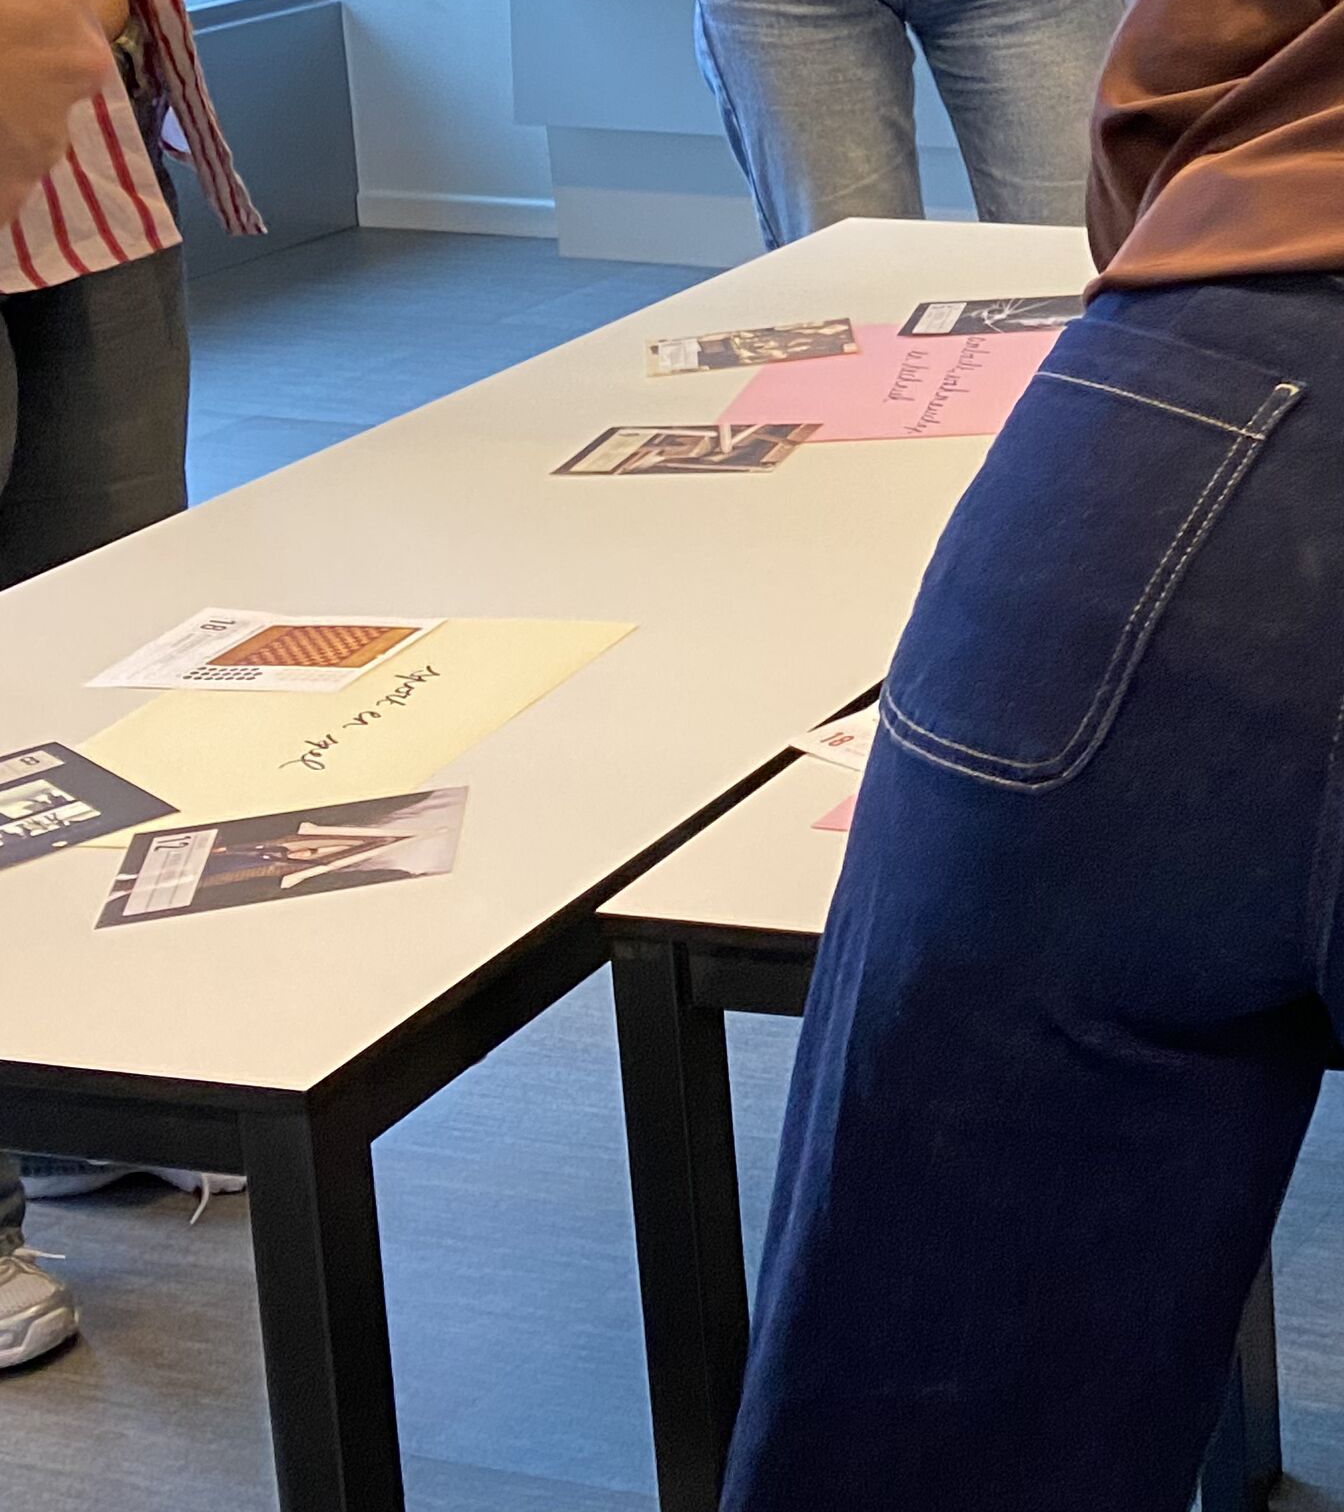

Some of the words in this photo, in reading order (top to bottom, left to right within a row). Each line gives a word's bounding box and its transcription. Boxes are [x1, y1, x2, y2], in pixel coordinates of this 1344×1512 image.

[199, 619, 236, 632] 18
[376, 665, 440, 706] sport
[342, 710, 381, 729] en
[820, 731, 855, 747] 18
[278, 733, 338, 771] spel
[153, 835, 191, 852] 12
